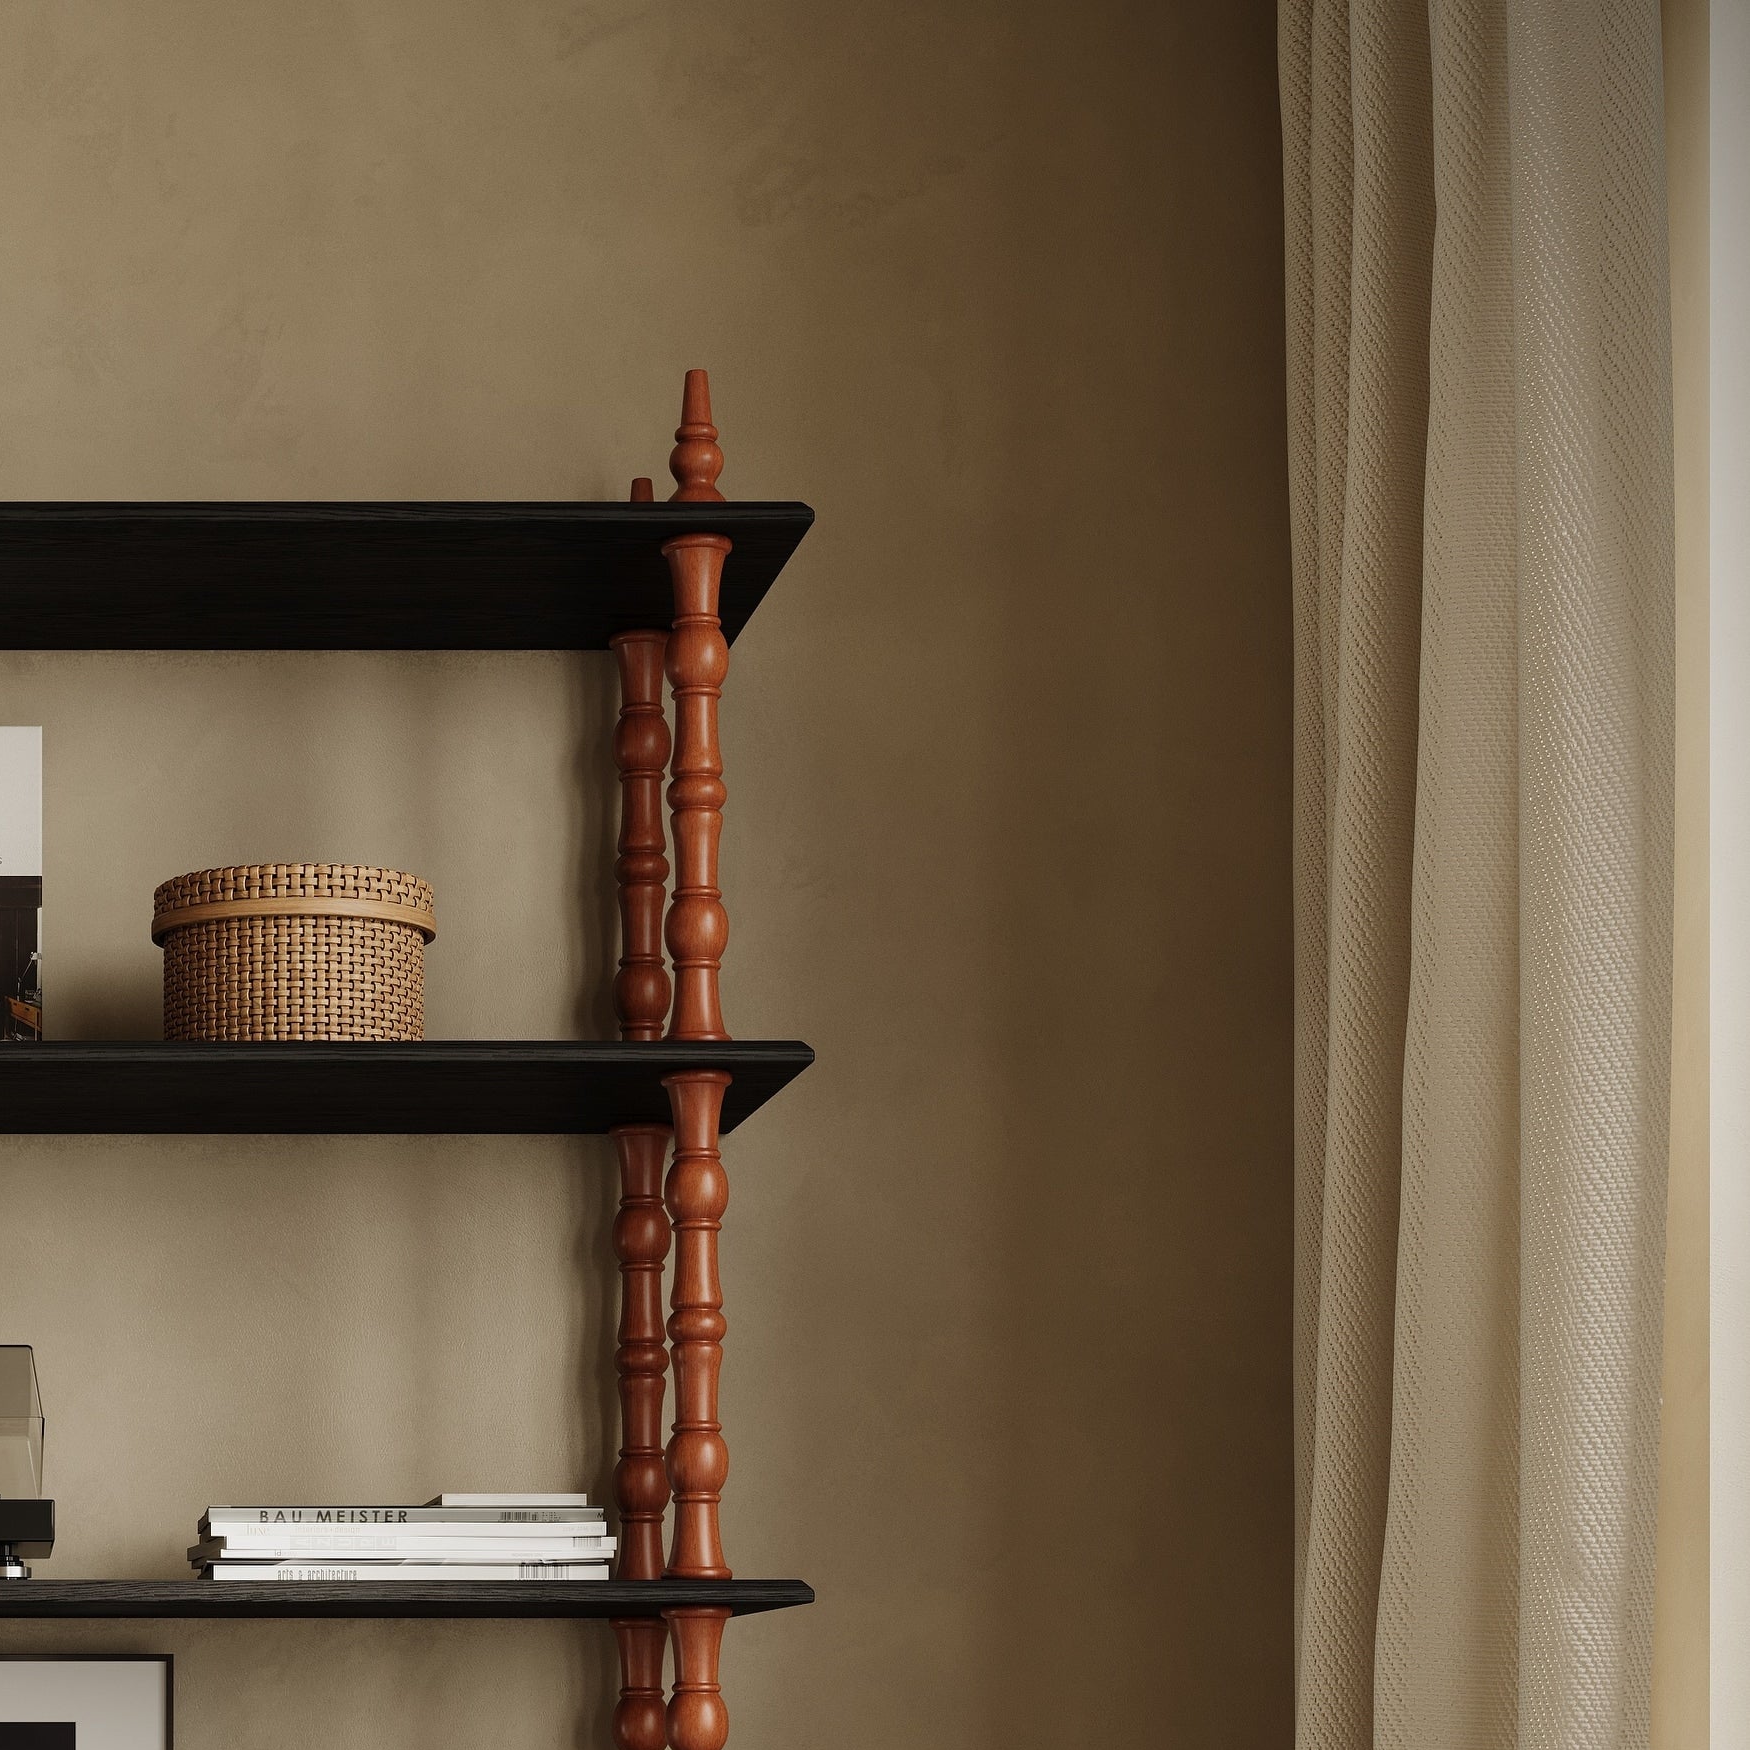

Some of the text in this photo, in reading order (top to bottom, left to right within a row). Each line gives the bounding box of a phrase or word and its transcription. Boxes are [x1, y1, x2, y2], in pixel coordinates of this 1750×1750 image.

[259, 1510, 408, 1523] BAU MEISTER
[277, 1569, 294, 1580] arts
[307, 1568, 357, 1580] architecture
